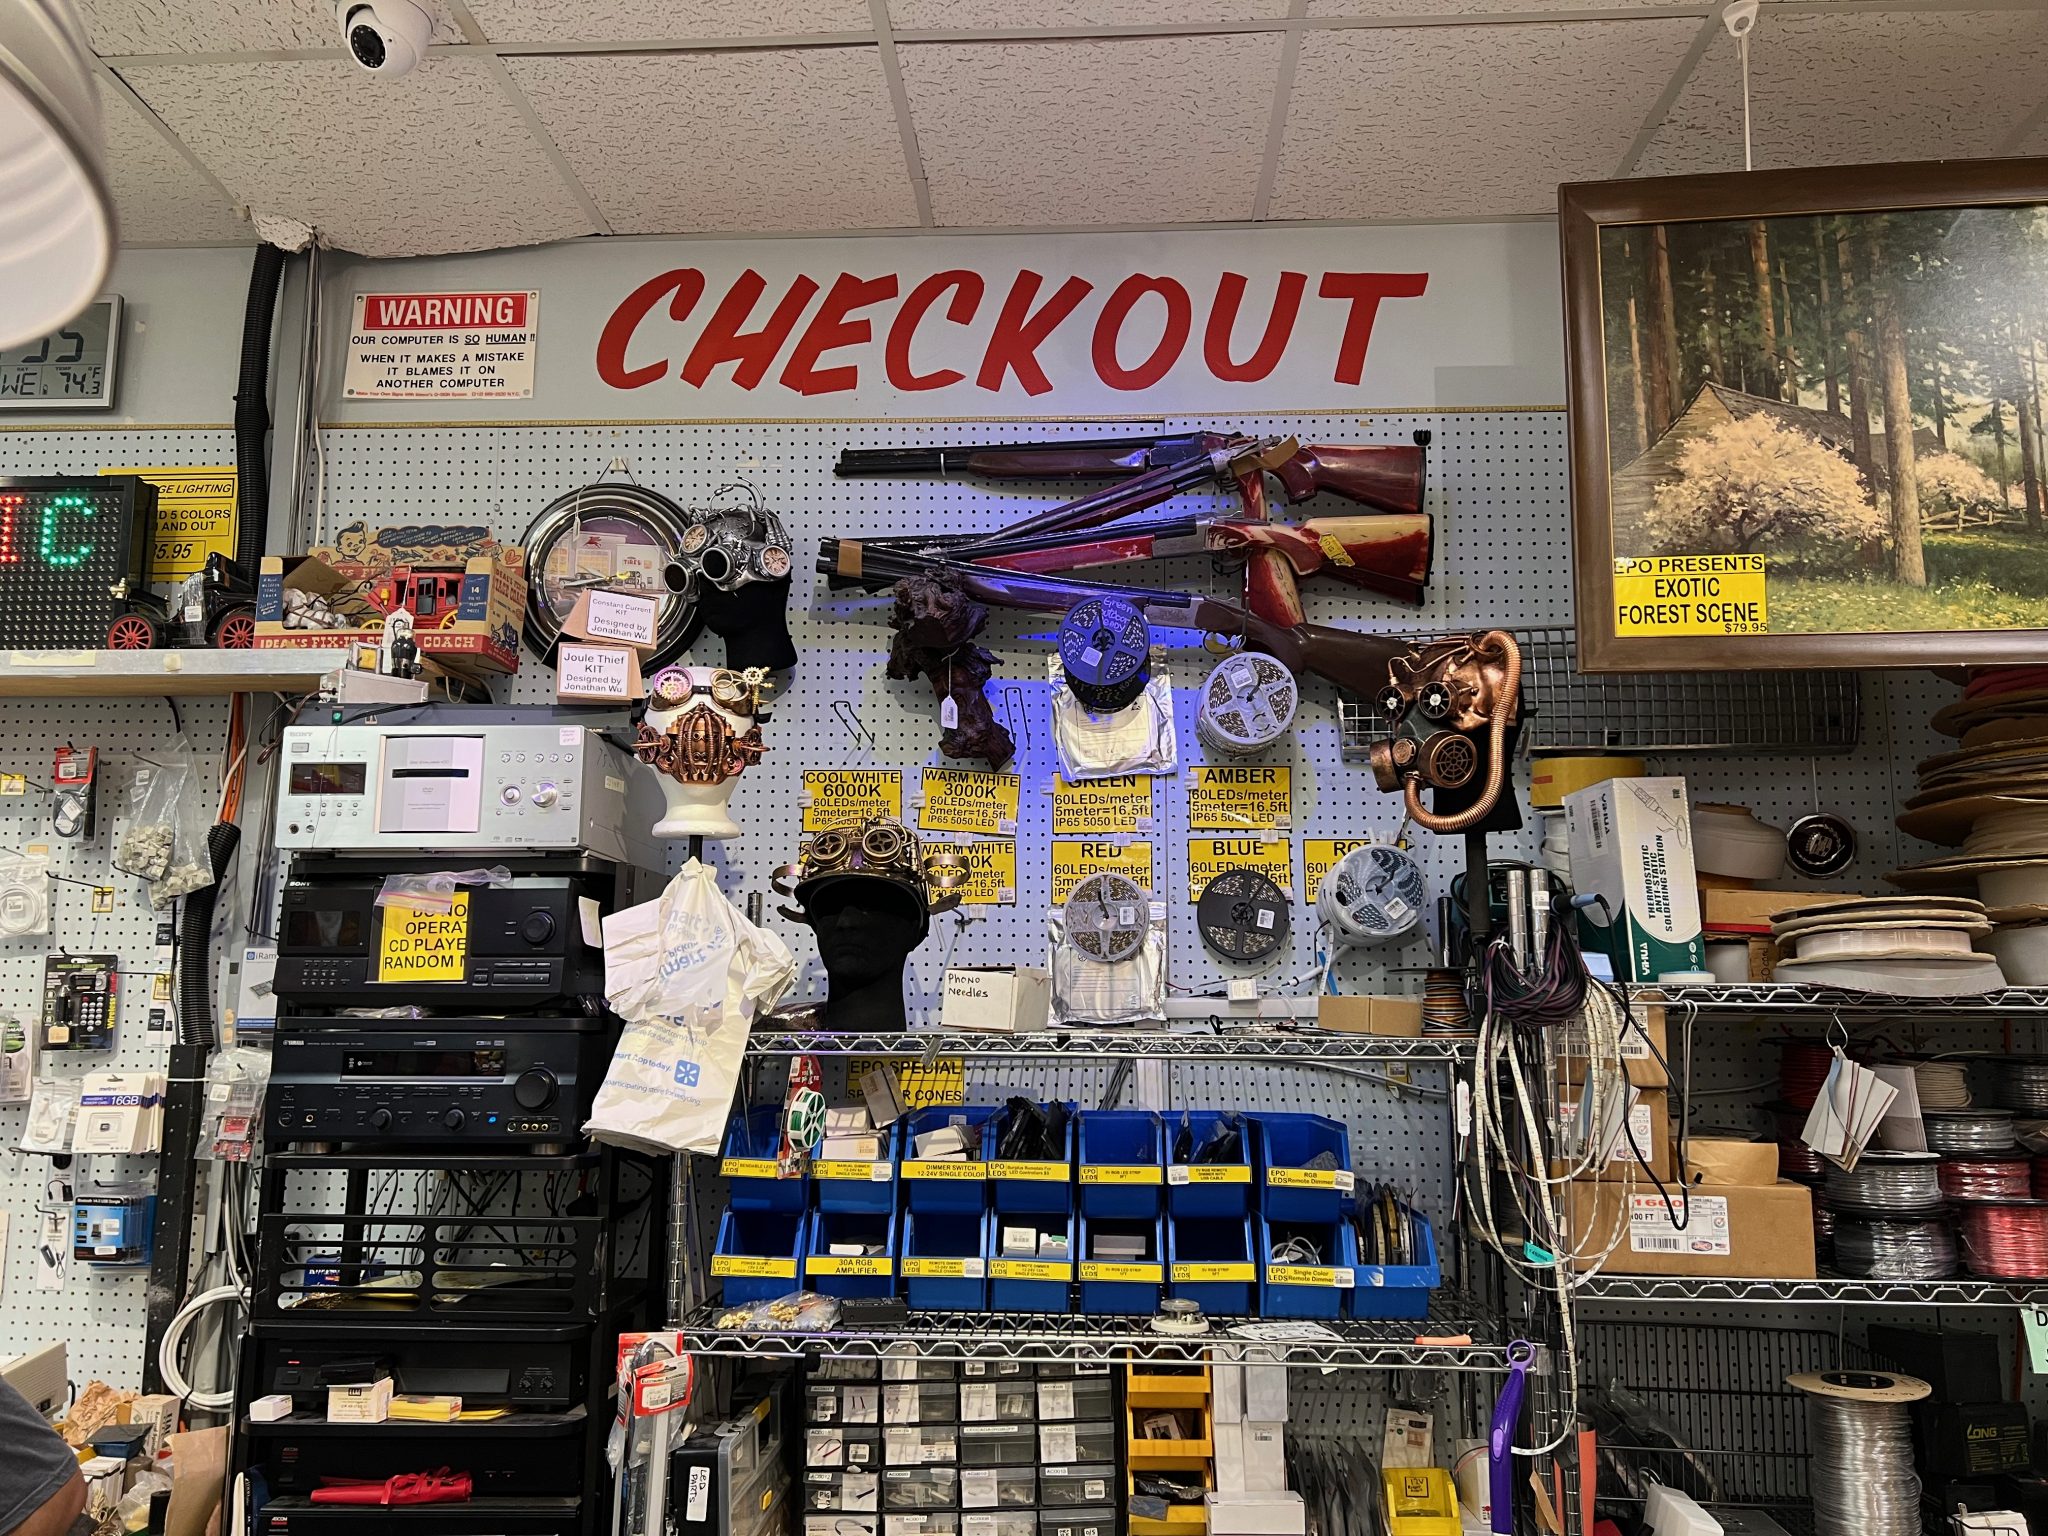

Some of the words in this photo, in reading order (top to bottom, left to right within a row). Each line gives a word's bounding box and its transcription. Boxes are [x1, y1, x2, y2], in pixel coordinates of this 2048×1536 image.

[379, 297, 514, 326] WARNING
[595, 267, 1430, 397] CHECKOUT
[352, 336, 376, 344] OUR
[381, 335, 444, 344] COMPUTER
[449, 335, 459, 344] IS
[464, 334, 480, 345] SO
[486, 333, 527, 344] HUMAN
[360, 354, 395, 363] WHEN
[400, 354, 411, 363] IT
[416, 354, 456, 363] MAKES
[462, 353, 470, 362] A
[475, 352, 525, 362] MISTAKE
[387, 367, 398, 376] IT
[406, 366, 453, 376] BLAMES
[460, 366, 470, 375] IT
[478, 366, 496, 374] ON
[376, 379, 434, 388] ANOTHER
[440, 378, 505, 388] COMPUTER
[176, 484, 232, 494] LIGHTING
[170, 510, 178, 519] 5
[180, 509, 230, 519] COLORS
[162, 522, 187, 531] AND
[191, 521, 216, 531] OUT
[1659, 556, 1763, 572] PRESENTS
[1655, 577, 1720, 598] EXOTIC
[592, 598, 625, 610] Constant
[626, 603, 651, 614] Current
[1619, 604, 1691, 624] FOREST
[1696, 602, 1759, 622] SCENE
[594, 616, 635, 630] Designed
[637, 624, 647, 632] by
[1724, 623, 1767, 634] $79.95
[592, 625, 632, 638] Jonathan
[634, 632, 648, 640] Wu
[423, 636, 475, 648] COACH
[564, 653, 594, 664] Joule
[598, 655, 625, 664] Thief
[585, 665, 604, 673] KIT
[566, 674, 608, 685] Designed
[610, 676, 622, 686] by
[564, 682, 606, 693] Jonathan
[607, 685, 623, 693] Wu
[806, 772, 849, 783] COOL
[851, 772, 899, 783] WHITE
[925, 769, 969, 783] WARM
[972, 774, 1019, 787] WHITE
[1204, 769, 1276, 784] AMBER
[824, 784, 881, 797] 6000K
[944, 783, 996, 799] 3000K
[1192, 790, 1288, 800] 60LEDs/meter
[813, 798, 891, 807] 60LEDs/meter
[930, 796, 1008, 809] 60LEDs/meter
[1055, 794, 1149, 805] 60LEDs/meter
[813, 808, 890, 817] 5meter=16.5ft
[929, 806, 1007, 819] 5meter=16.5ft
[1055, 804, 1149, 816] 5meter=16.5ft
[1192, 801, 1288, 813] 5meter=16.5ft
[927, 815, 948, 824] IP65
[950, 816, 973, 825] 5050
[975, 818, 995, 827] LED
[1055, 817, 1081, 826] IP65
[1083, 817, 1110, 826] 5050
[1113, 816, 1137, 826] LED
[1192, 812, 1217, 822] IP65
[1251, 812, 1275, 822] LED
[922, 844, 963, 855] WARM
[968, 843, 1015, 854] WHITE
[1081, 843, 1122, 858] RED
[1213, 840, 1265, 856] BLUE
[1656, 834, 1667, 876] STATION
[1054, 864, 1149, 875] 60LEDs/meter
[1191, 862, 1287, 873] 60LEDs/meter
[1642, 844, 1656, 919] THERMOSTATIC
[1650, 852, 1663, 913] ANTI-STATIC
[1660, 877, 1673, 931] SOLDERING
[389, 940, 410, 952] CD
[414, 938, 466, 951] PLAYE
[385, 955, 454, 969] RANDOM
[850, 1060, 885, 1074] EPO
[890, 1060, 961, 1074] SPECIAL
[111, 1096, 138, 1105] 16GB
[917, 1090, 962, 1100] CONES
[1967, 1424, 1997, 1439] LONG
